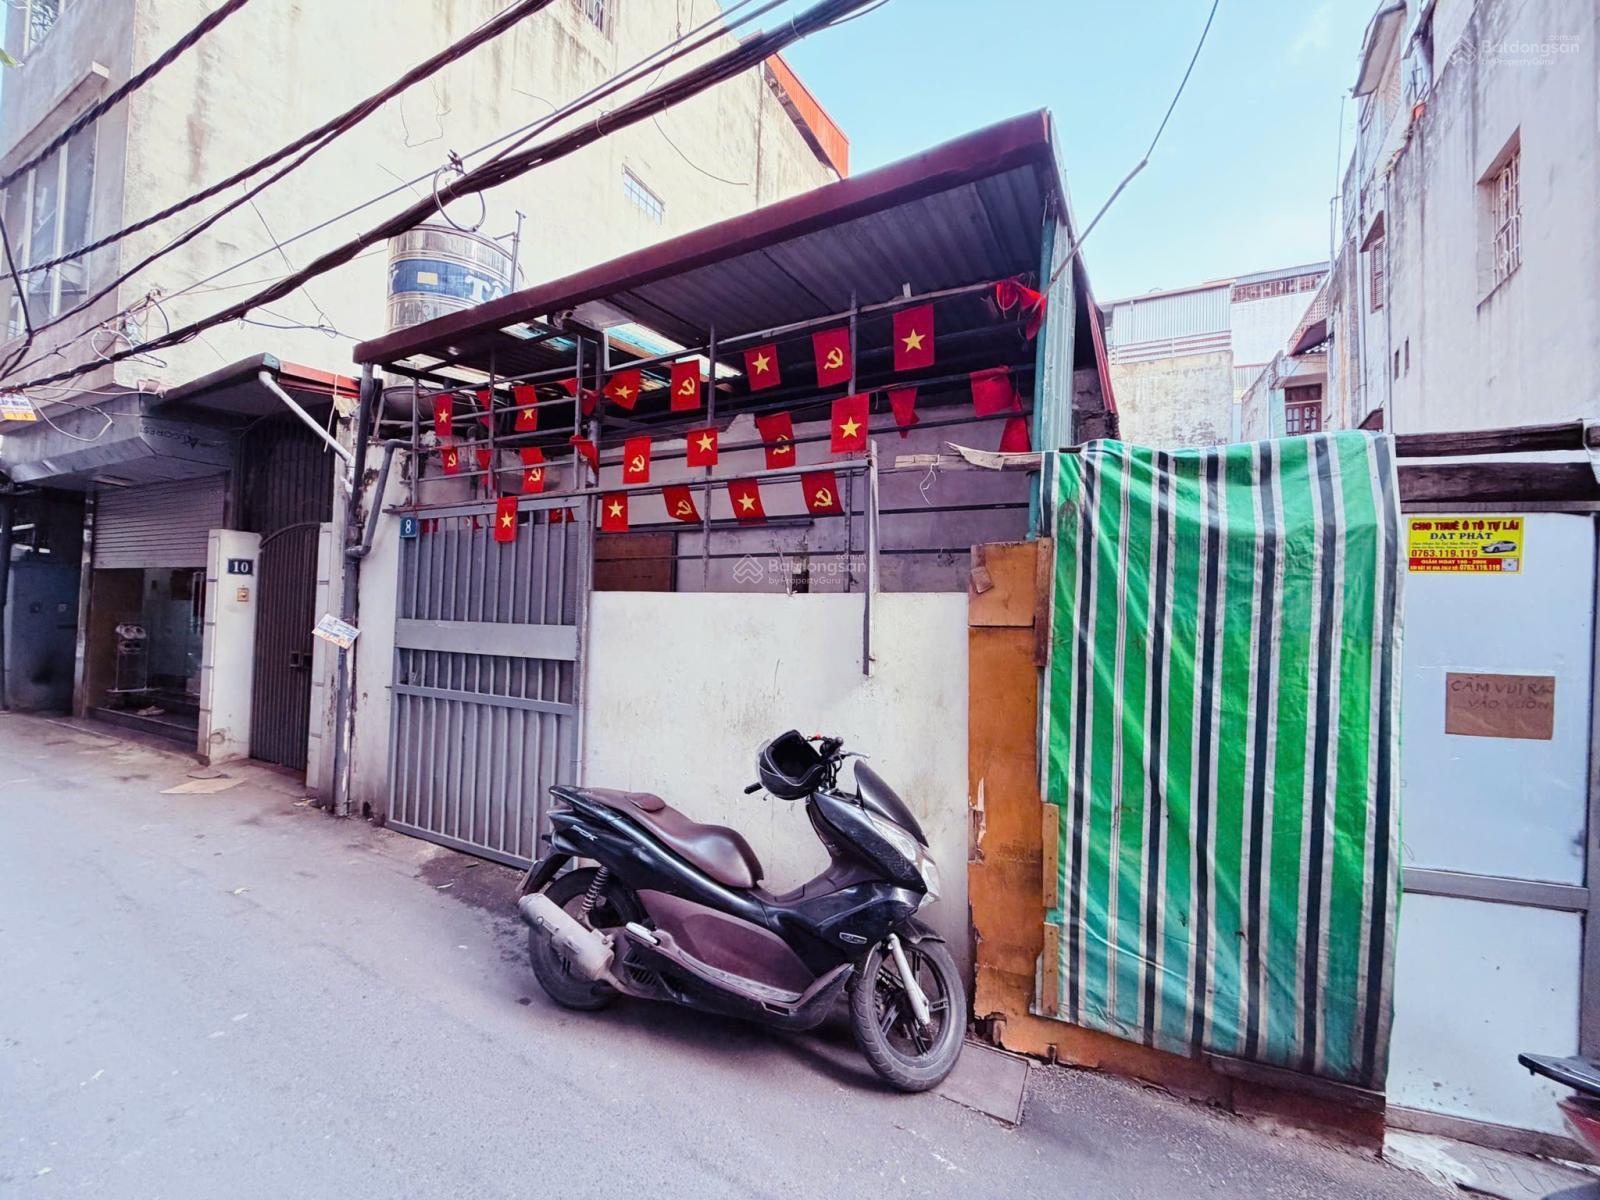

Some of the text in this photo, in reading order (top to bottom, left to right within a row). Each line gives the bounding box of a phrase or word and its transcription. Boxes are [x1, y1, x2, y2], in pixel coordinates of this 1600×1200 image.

[405, 519, 412, 534] 8
[1412, 520, 1520, 532] CHO THUÊ Ô TÔ TỰ LÁI
[1459, 530, 1493, 540] PHÁT
[1411, 549, 1478, 557] 0763.119.119
[233, 561, 249, 573] 10
